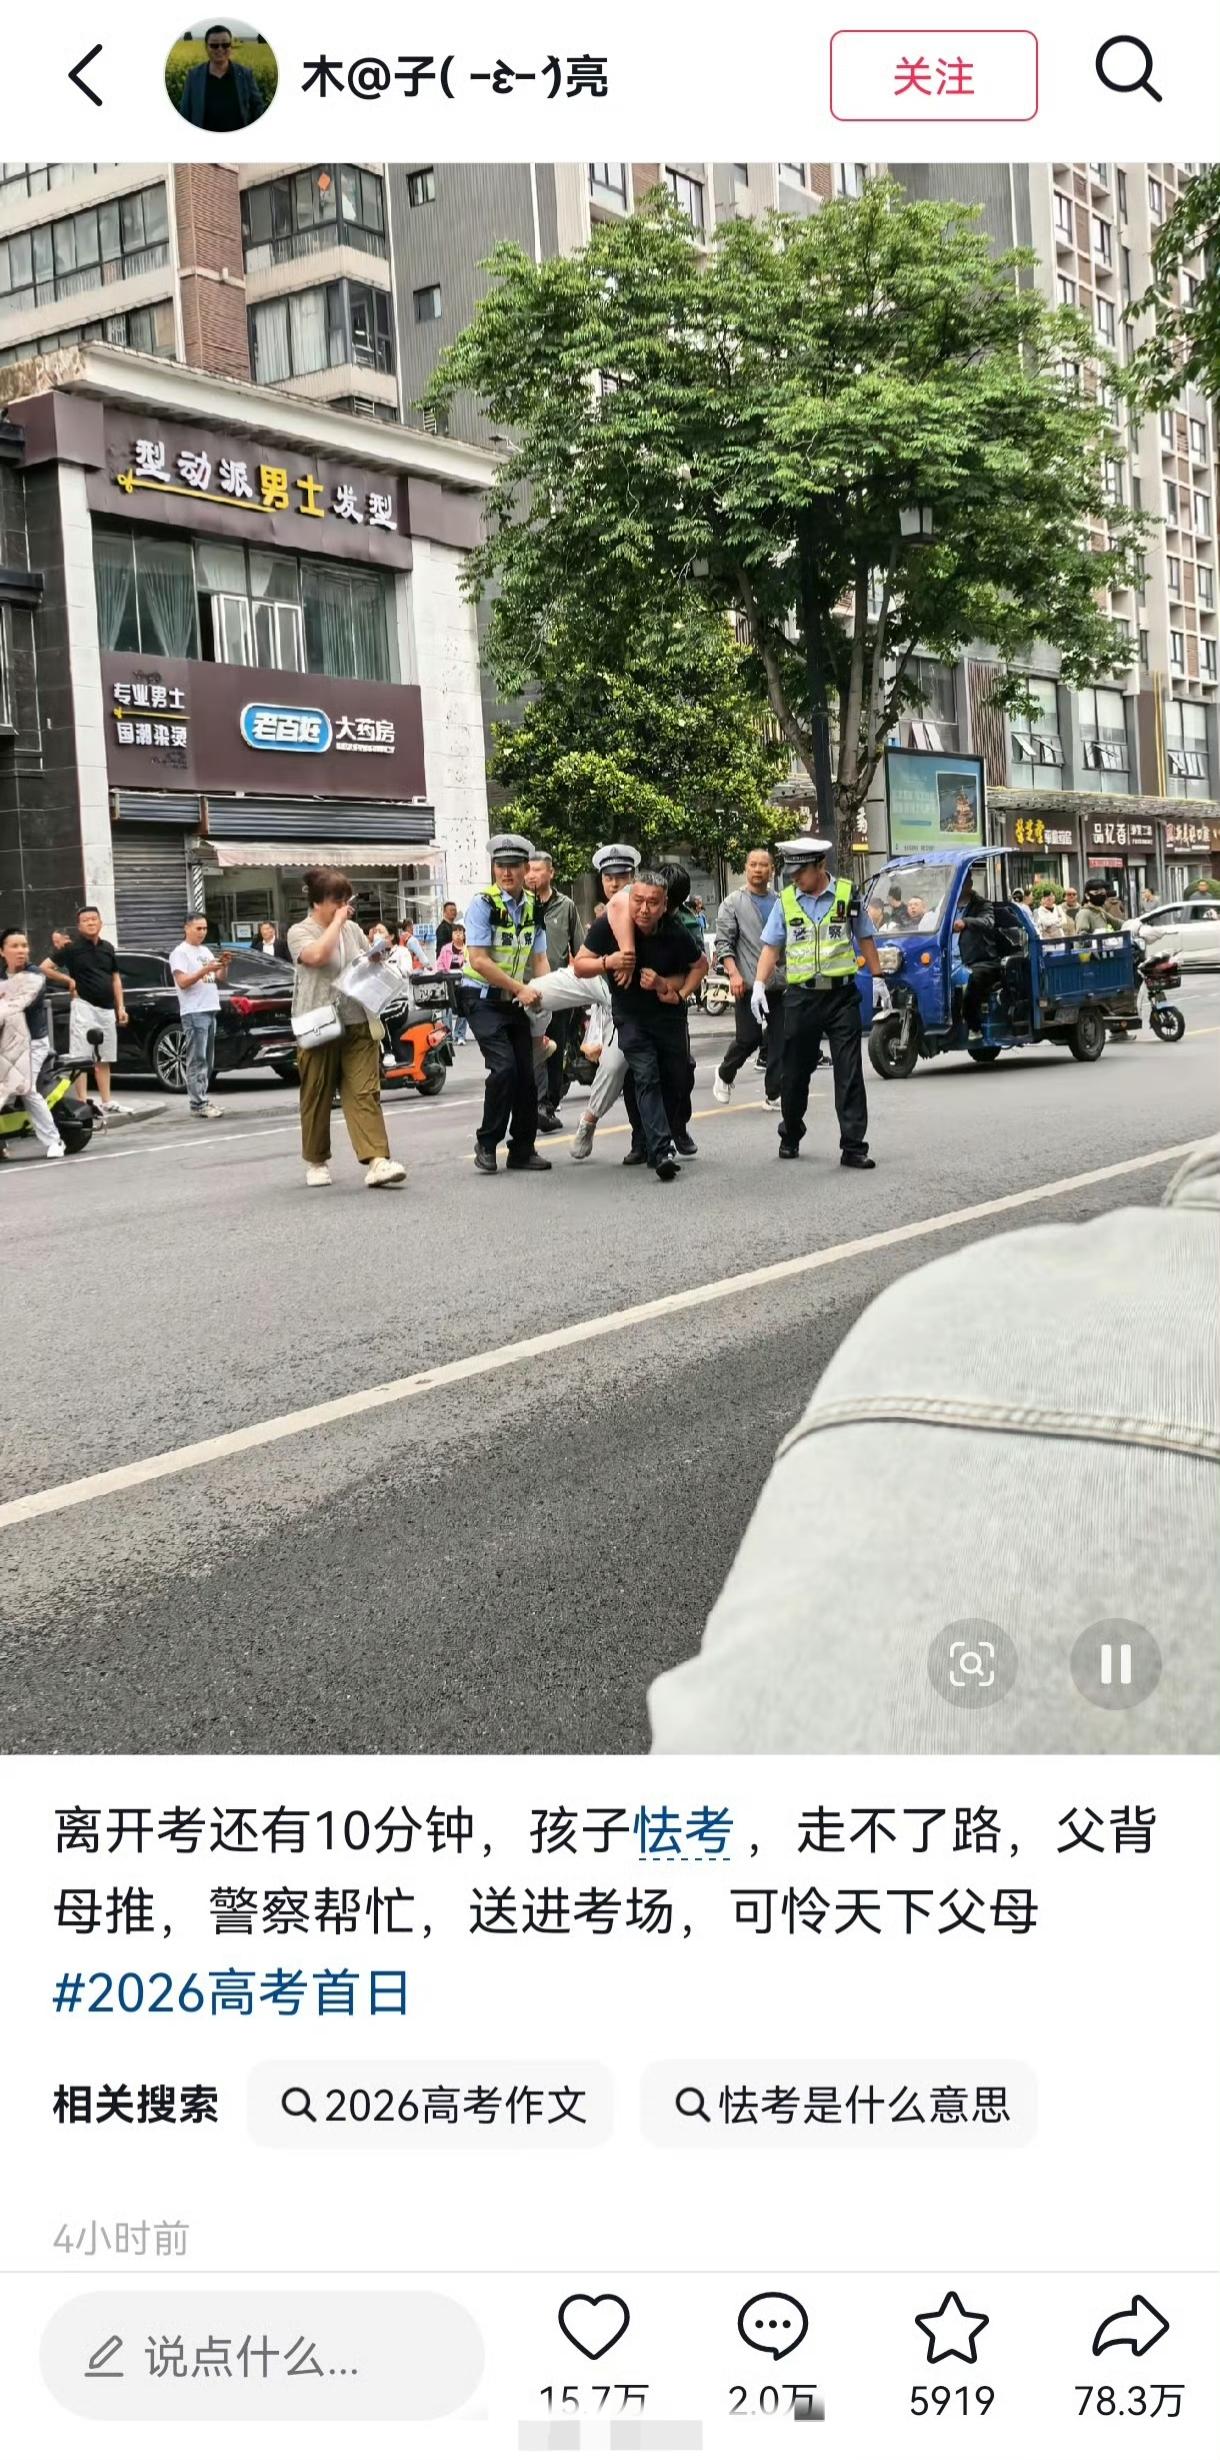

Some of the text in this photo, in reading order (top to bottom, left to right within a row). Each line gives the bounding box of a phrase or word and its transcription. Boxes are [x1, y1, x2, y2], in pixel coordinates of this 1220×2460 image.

[136, 439, 397, 531] 型动派男士发型
[113, 682, 185, 709] 专业男士
